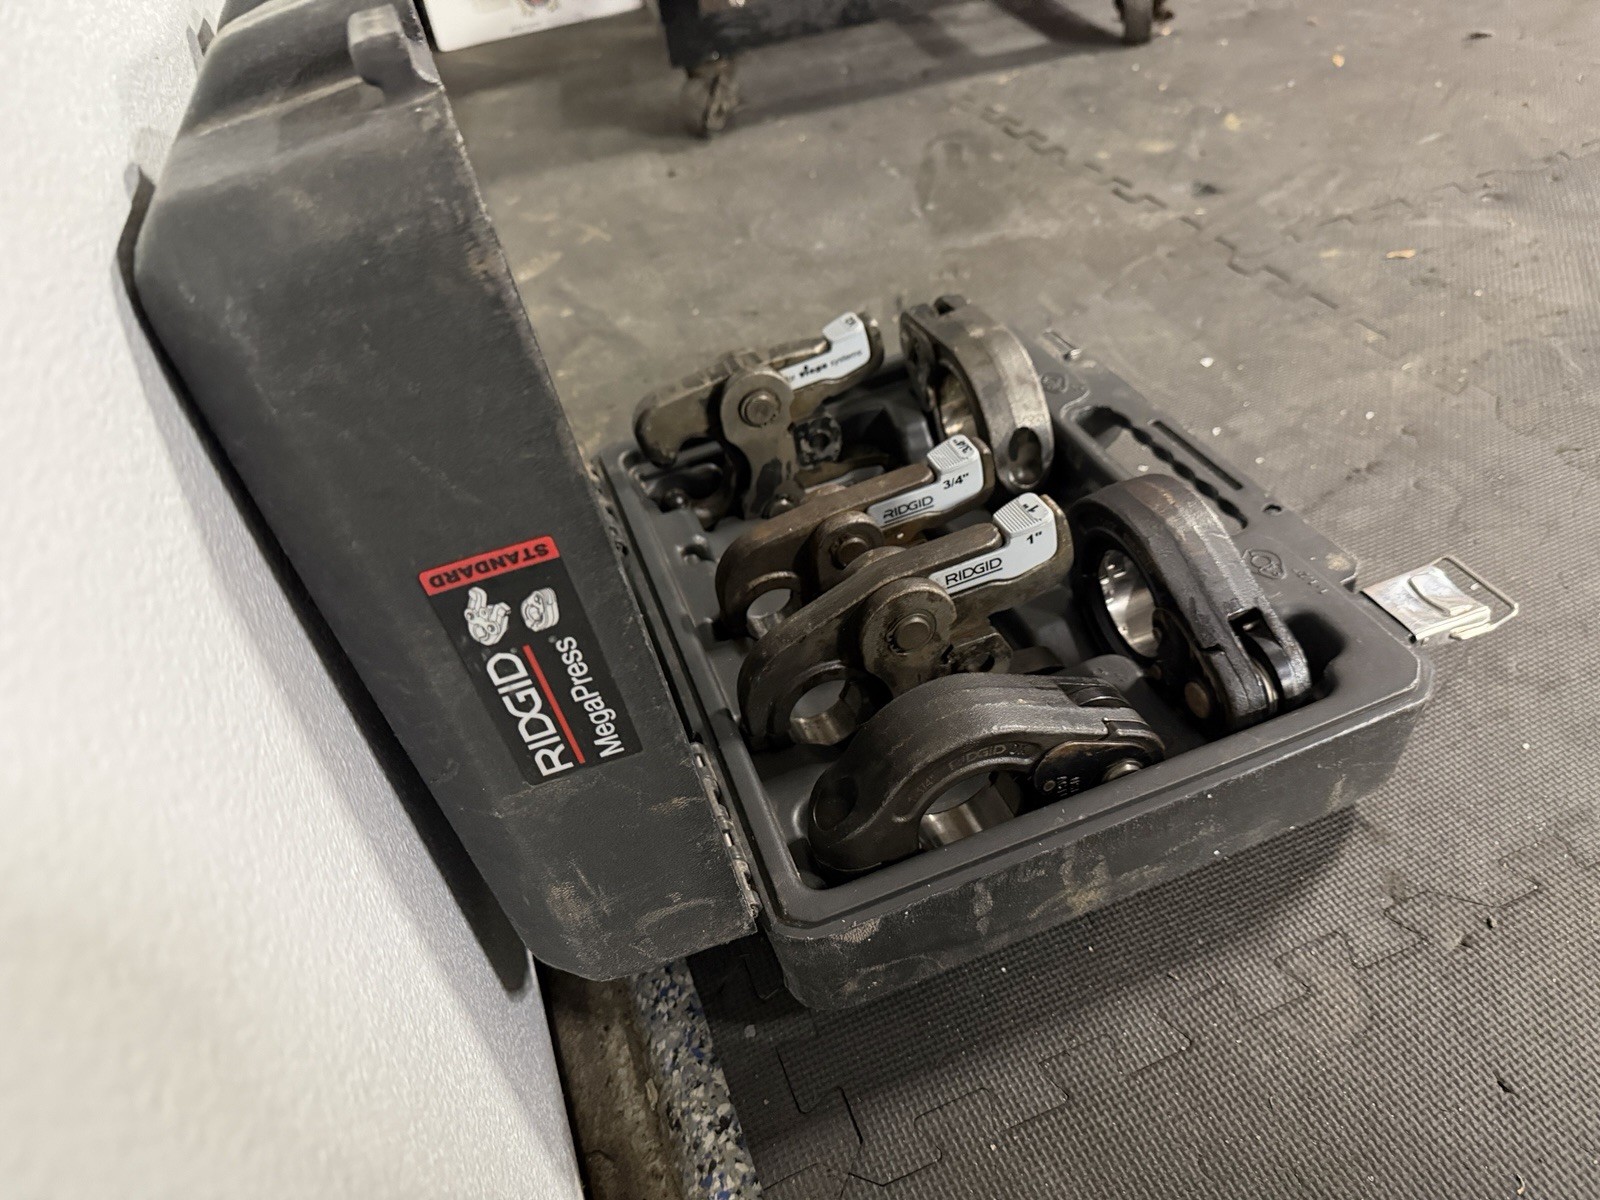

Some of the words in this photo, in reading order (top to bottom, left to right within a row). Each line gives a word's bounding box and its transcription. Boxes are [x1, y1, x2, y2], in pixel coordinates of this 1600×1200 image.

[943, 472, 970, 490] 3/4"
[882, 495, 934, 519] RIDGID
[1022, 503, 1040, 514] 1"
[1026, 530, 1043, 545] 1"
[429, 542, 550, 589] STANDARD
[944, 557, 1003, 586] RIDGID
[555, 636, 625, 758] MegaPress
[486, 652, 574, 777] RIDGID
